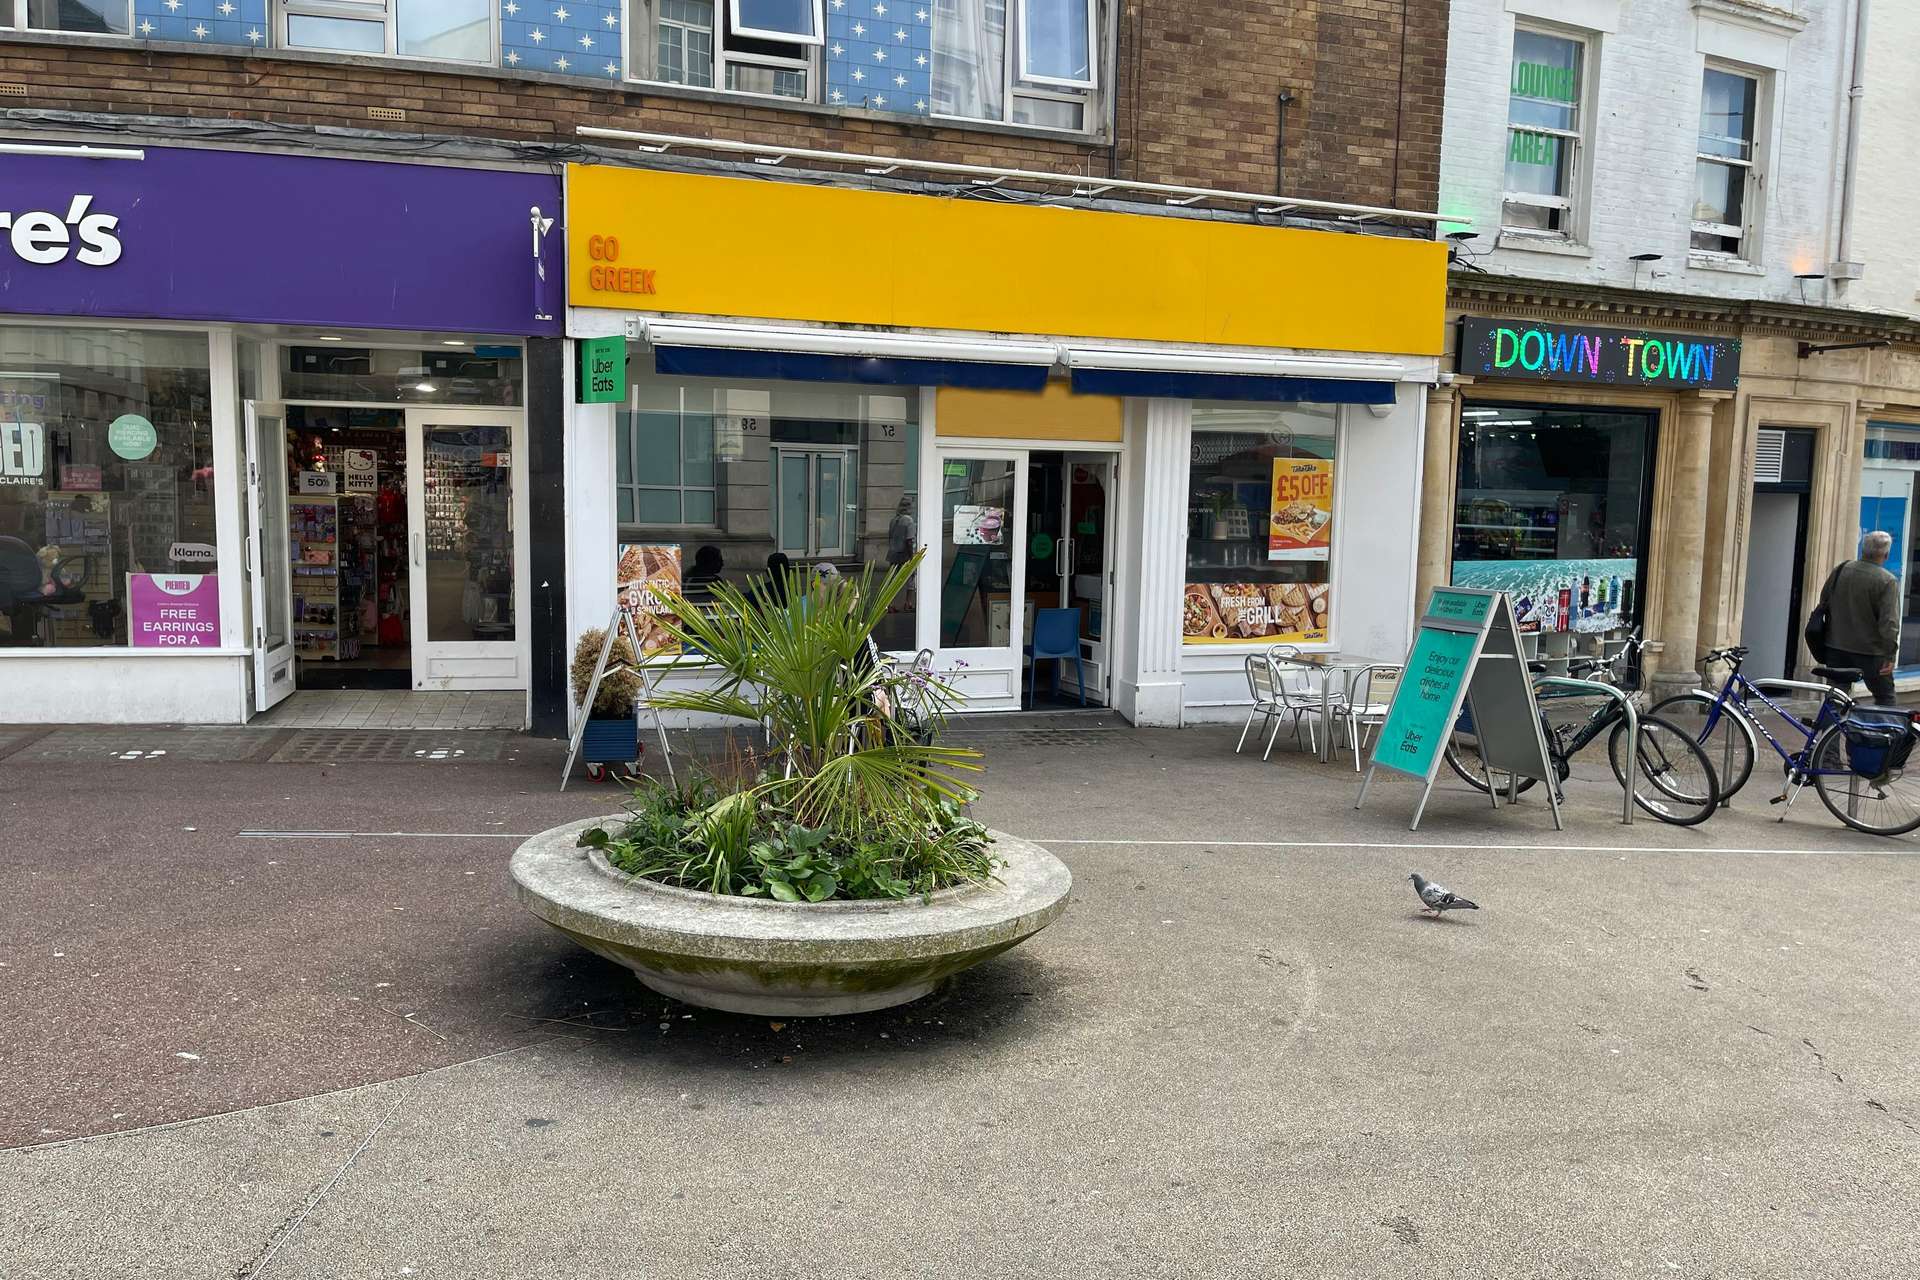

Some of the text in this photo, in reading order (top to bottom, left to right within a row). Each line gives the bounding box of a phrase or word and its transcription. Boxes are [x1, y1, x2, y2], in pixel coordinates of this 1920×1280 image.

[1511, 61, 1575, 102] OUNGE
[1509, 130, 1553, 166] AREA
[589, 234, 620, 262] GO
[590, 264, 656, 295] GREEK
[1495, 328, 1714, 381] DOWN TOWN
[592, 358, 613, 374] Uber
[592, 377, 614, 392] Eats
[0, 422, 44, 476] ED
[0, 476, 44, 486] CLAIRE'S
[1277, 473, 1329, 501] £5 OFF
[1220, 596, 1265, 609] FRESH FROM
[160, 609, 197, 619] FREE
[1246, 606, 1281, 625] GRILL
[143, 621, 214, 632] EARRINGS
[158, 634, 200, 645] FOR A
[1429, 651, 1461, 665] Enjoy our
[1420, 689, 1441, 702] home
[1405, 728, 1423, 742] Uber
[1400, 741, 1418, 754] Eats
